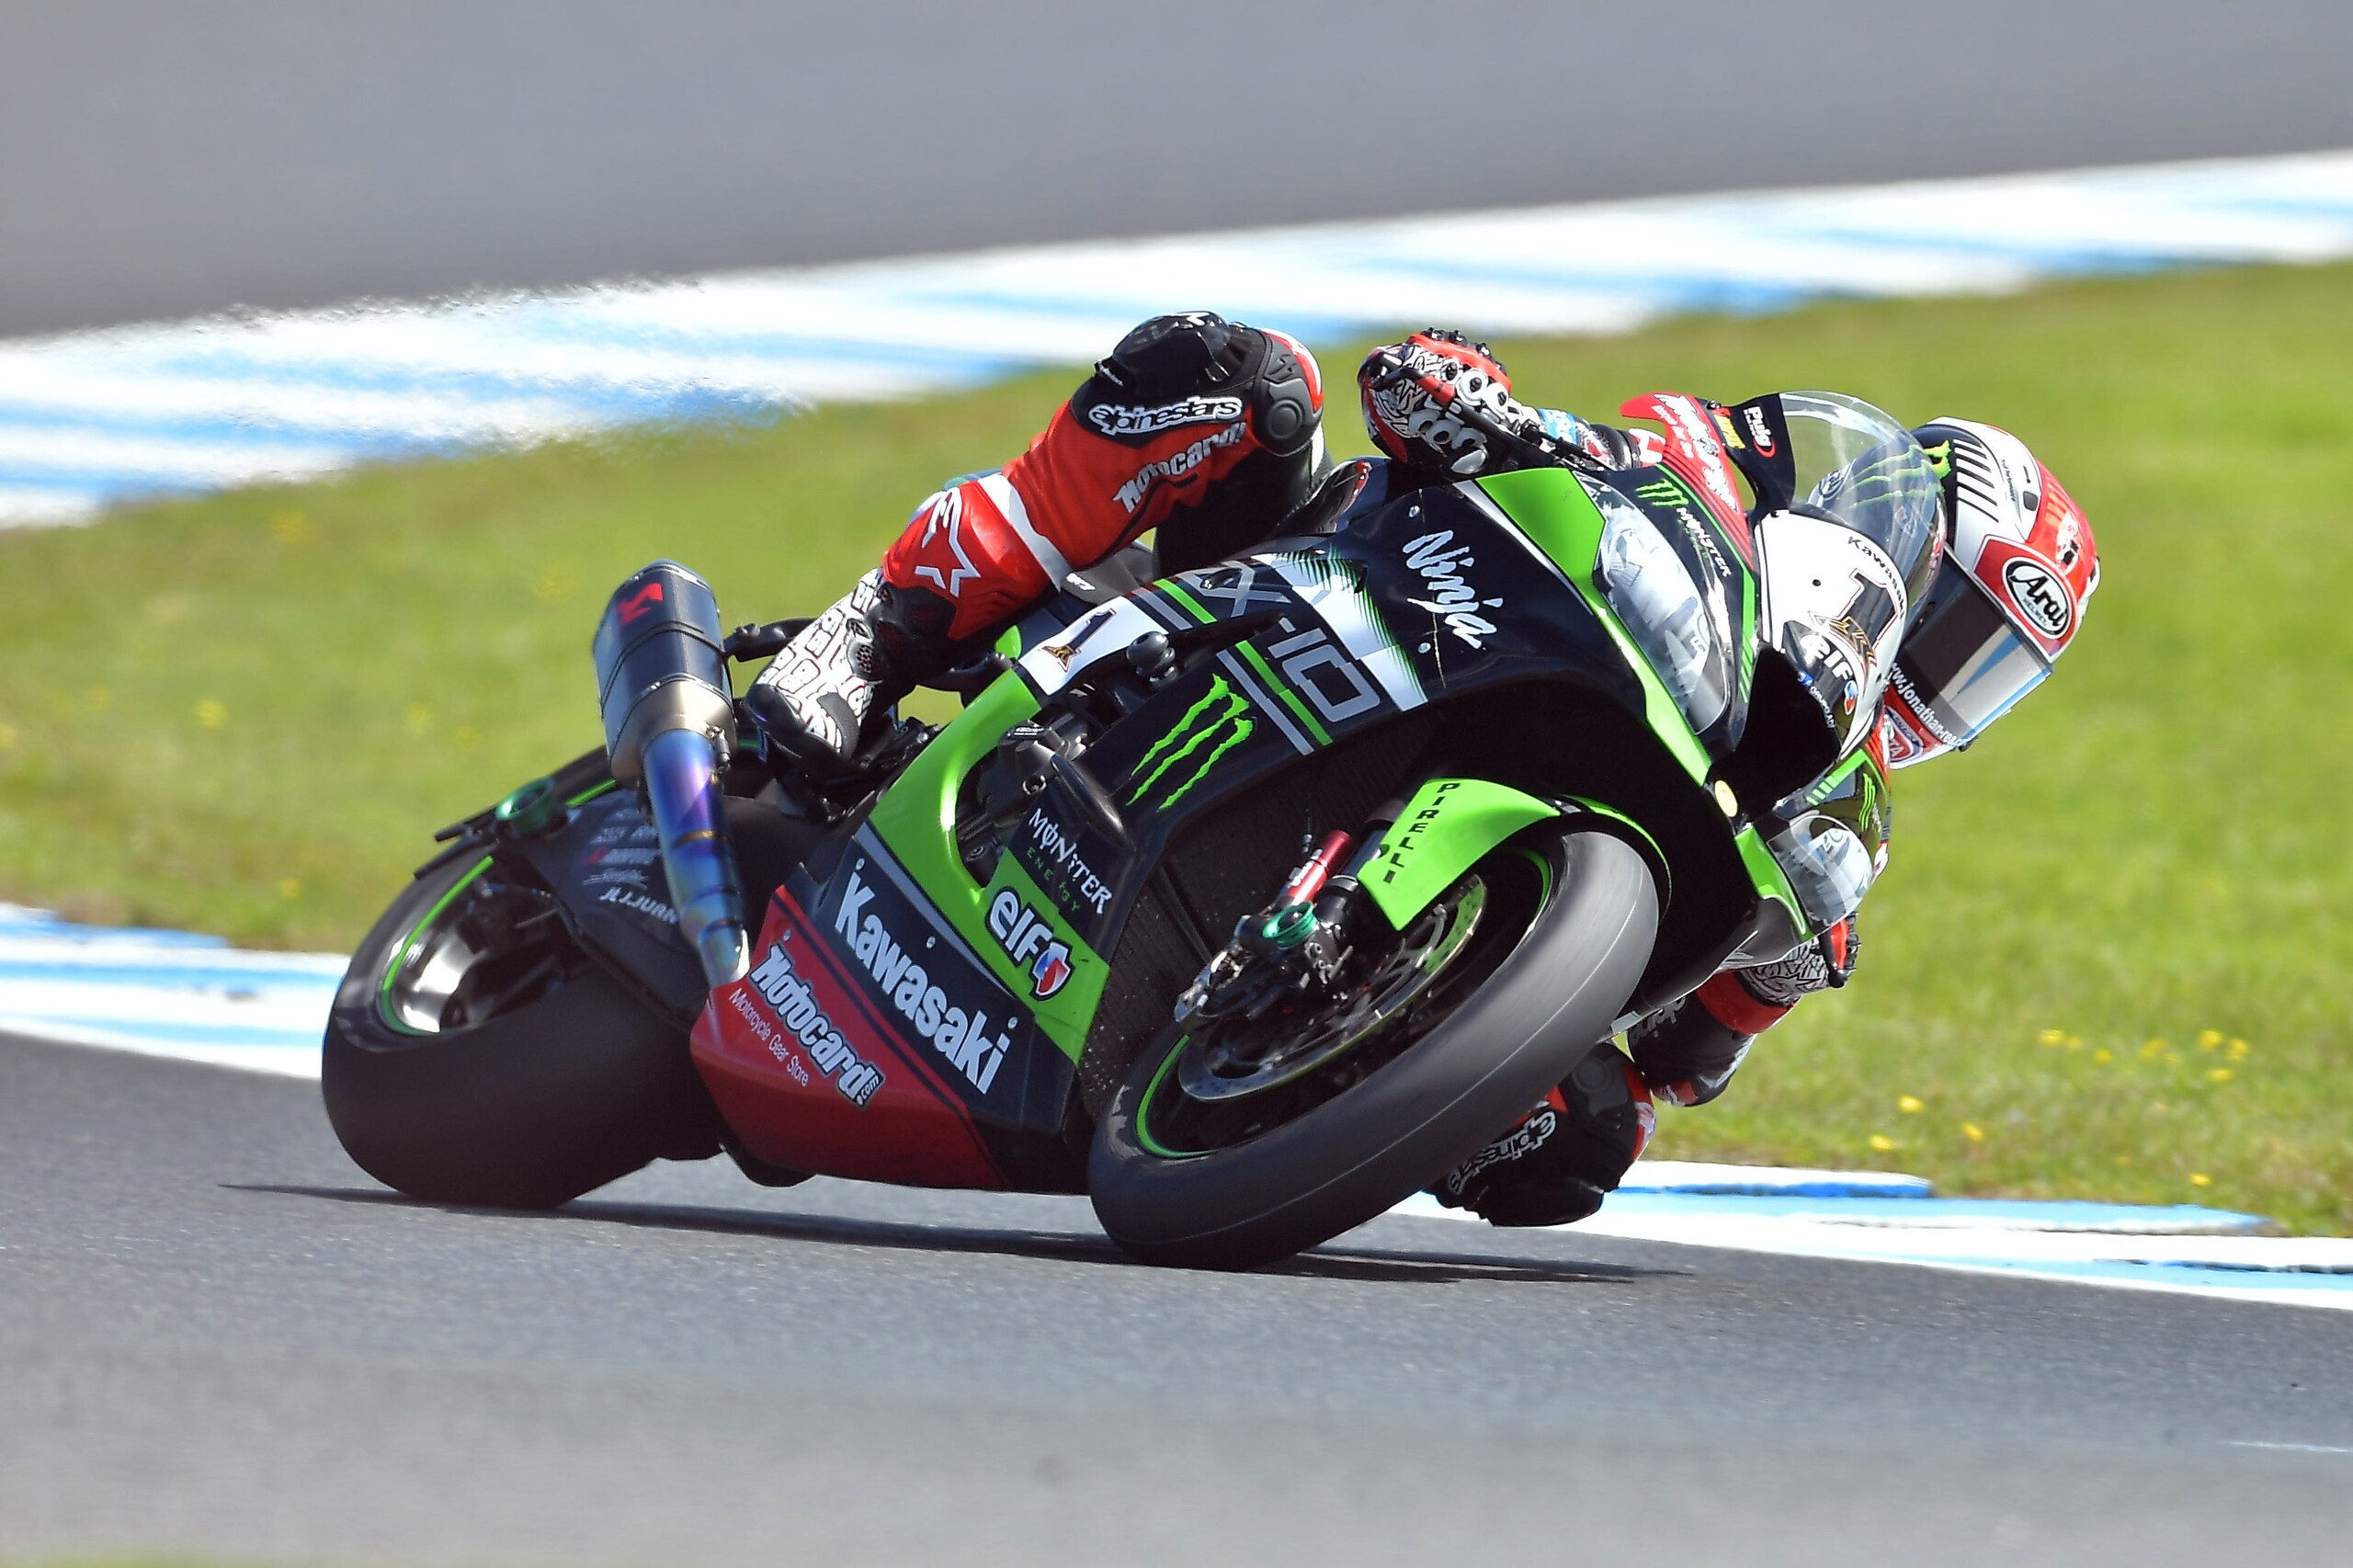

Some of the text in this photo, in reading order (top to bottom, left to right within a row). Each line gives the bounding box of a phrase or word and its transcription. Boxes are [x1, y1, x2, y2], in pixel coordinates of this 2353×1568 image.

[1746, 405, 1771, 448] Puig
[1676, 507, 1732, 578] MONSTER
[1847, 536, 1904, 619] Kawasaki
[1403, 529, 1505, 650] Ninja
[2007, 568, 2069, 627] Arai
[1029, 807, 1113, 915] MONSTER
[1384, 782, 1461, 884] PIRELLI
[990, 892, 1052, 973] elf
[835, 870, 1010, 1096] Kawasaki
[729, 987, 809, 1086] Motorcycle Gear Store
